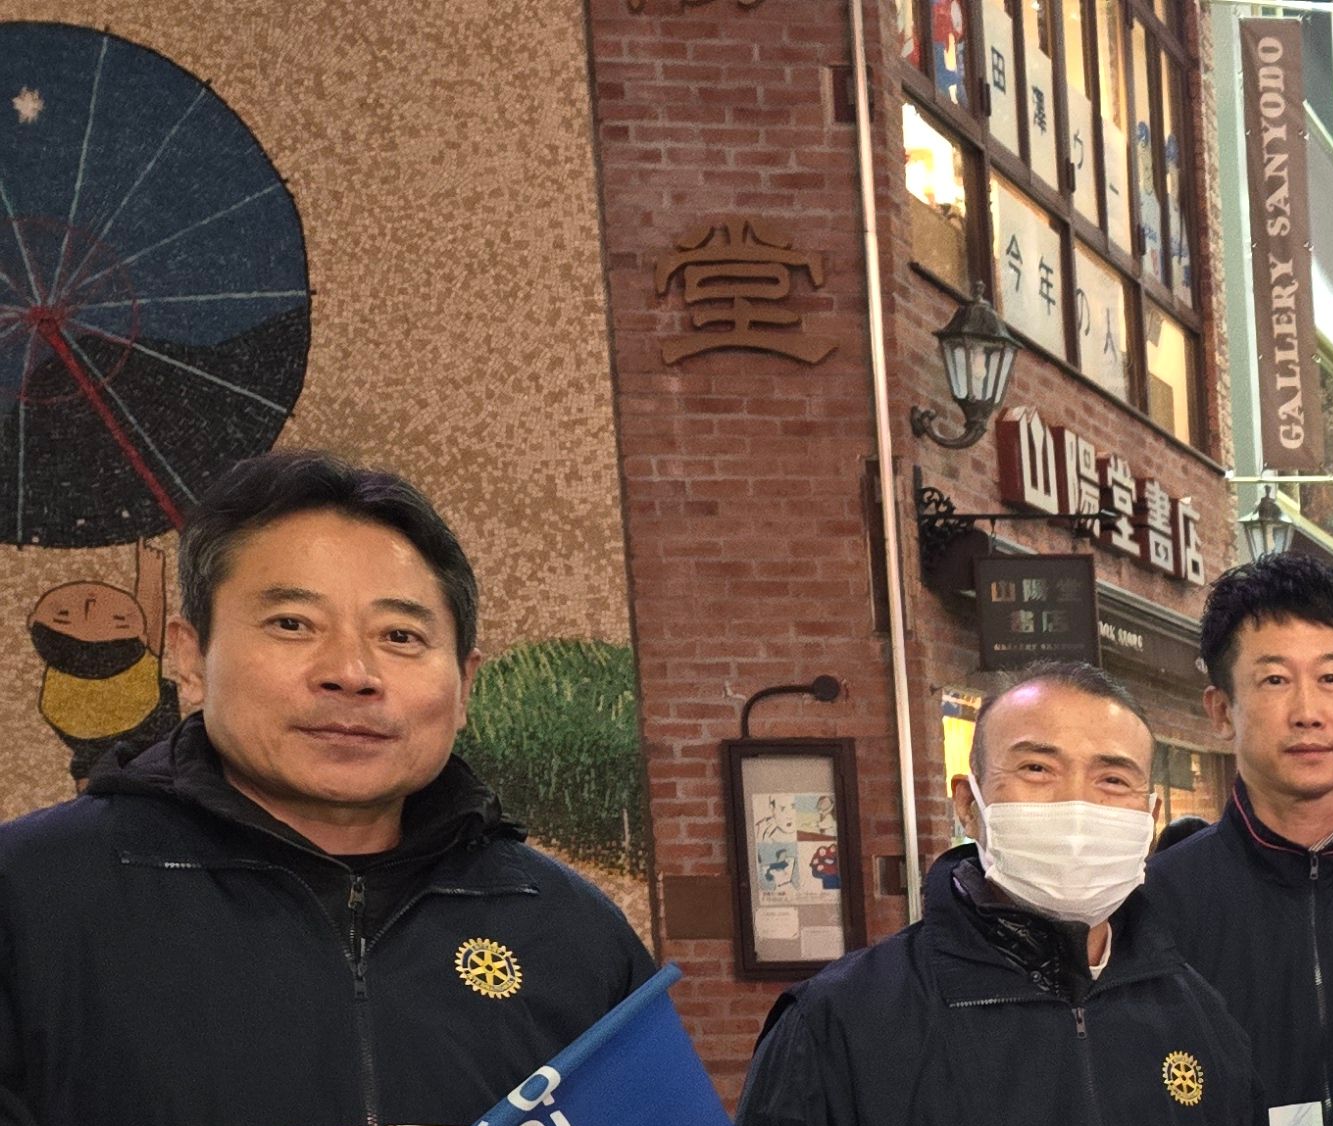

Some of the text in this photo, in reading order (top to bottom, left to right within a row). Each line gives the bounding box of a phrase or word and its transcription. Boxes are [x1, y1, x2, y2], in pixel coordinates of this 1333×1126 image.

[1004, 233, 1117, 366] 今年の人
[1257, 36, 1305, 449] GALLERY SANYODO
[1019, 410, 1205, 586] 山陽堂書店
